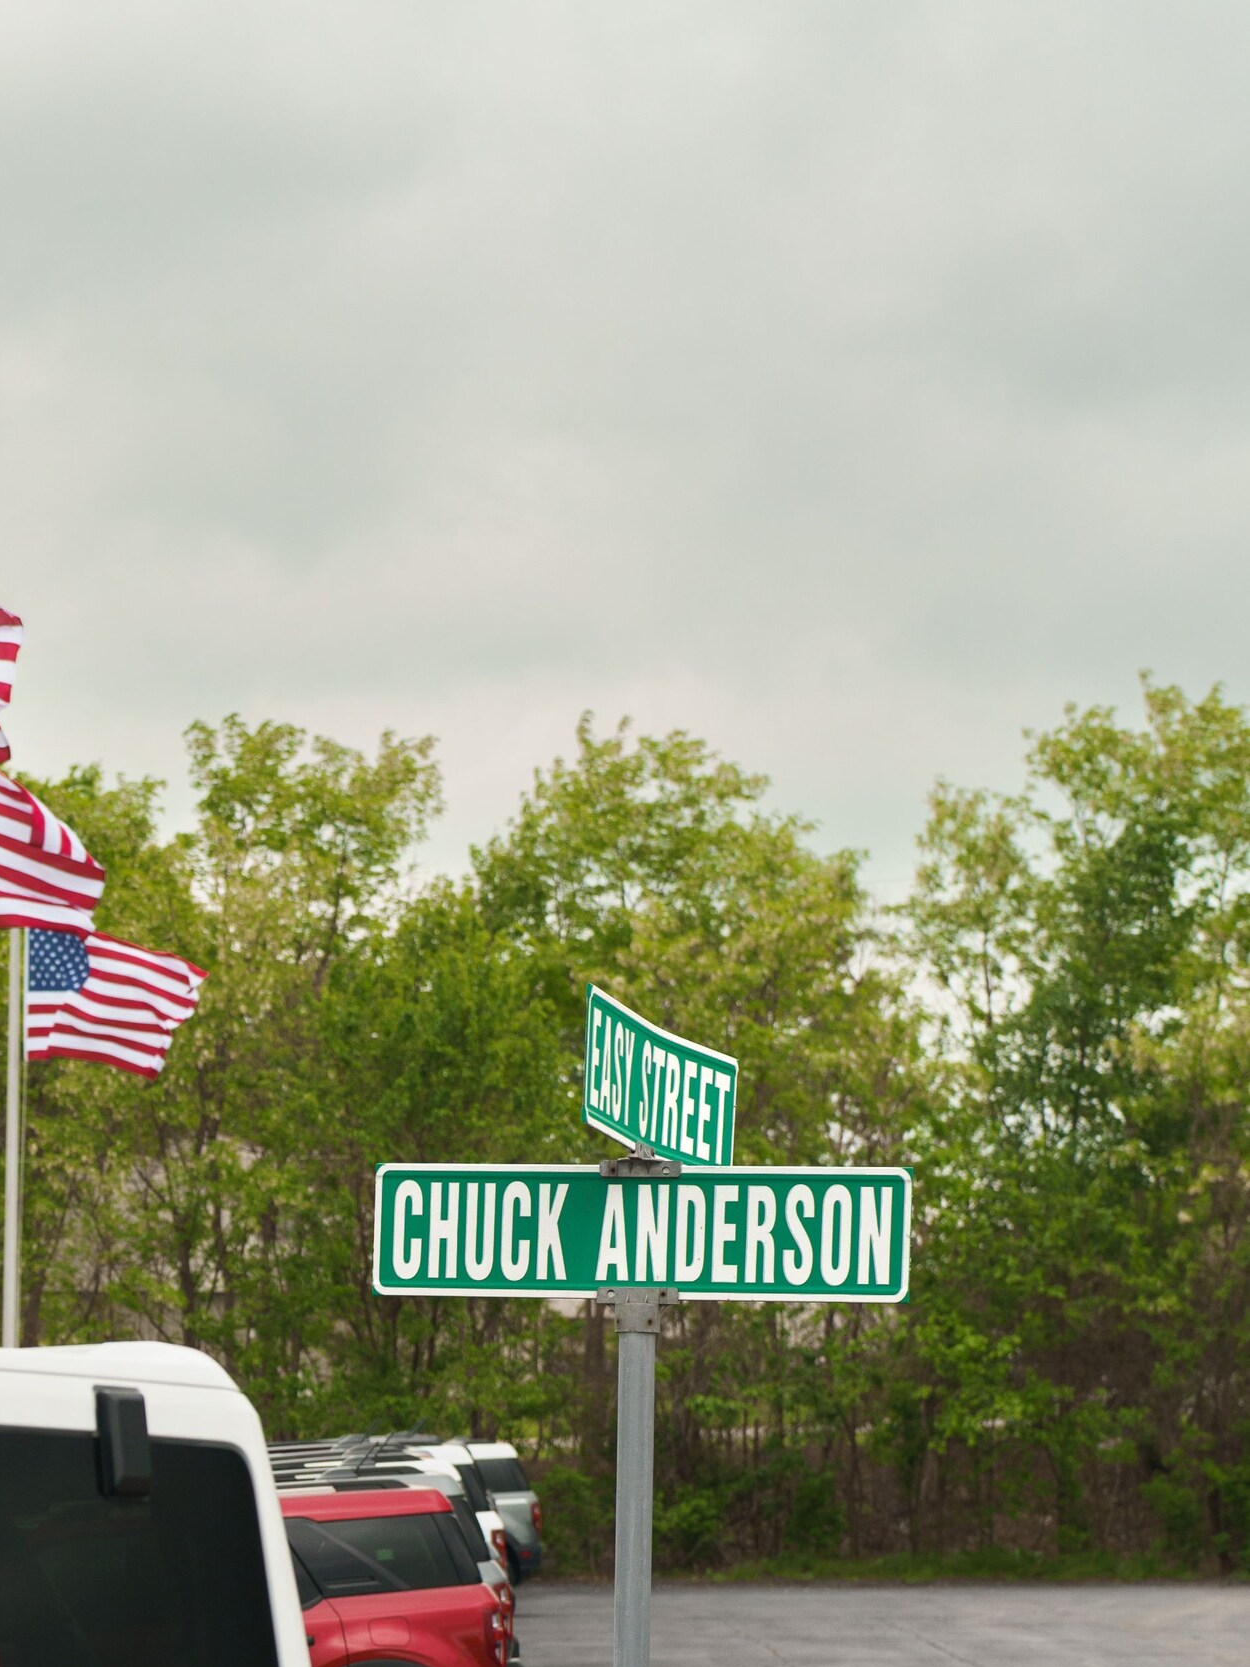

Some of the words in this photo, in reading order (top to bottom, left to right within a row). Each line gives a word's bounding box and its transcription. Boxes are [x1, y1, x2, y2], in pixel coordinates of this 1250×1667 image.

[589, 1006, 636, 1127] EASY
[639, 1039, 731, 1166] STREET
[392, 1179, 570, 1282] CHUCK
[595, 1183, 894, 1287] ANDERSON
